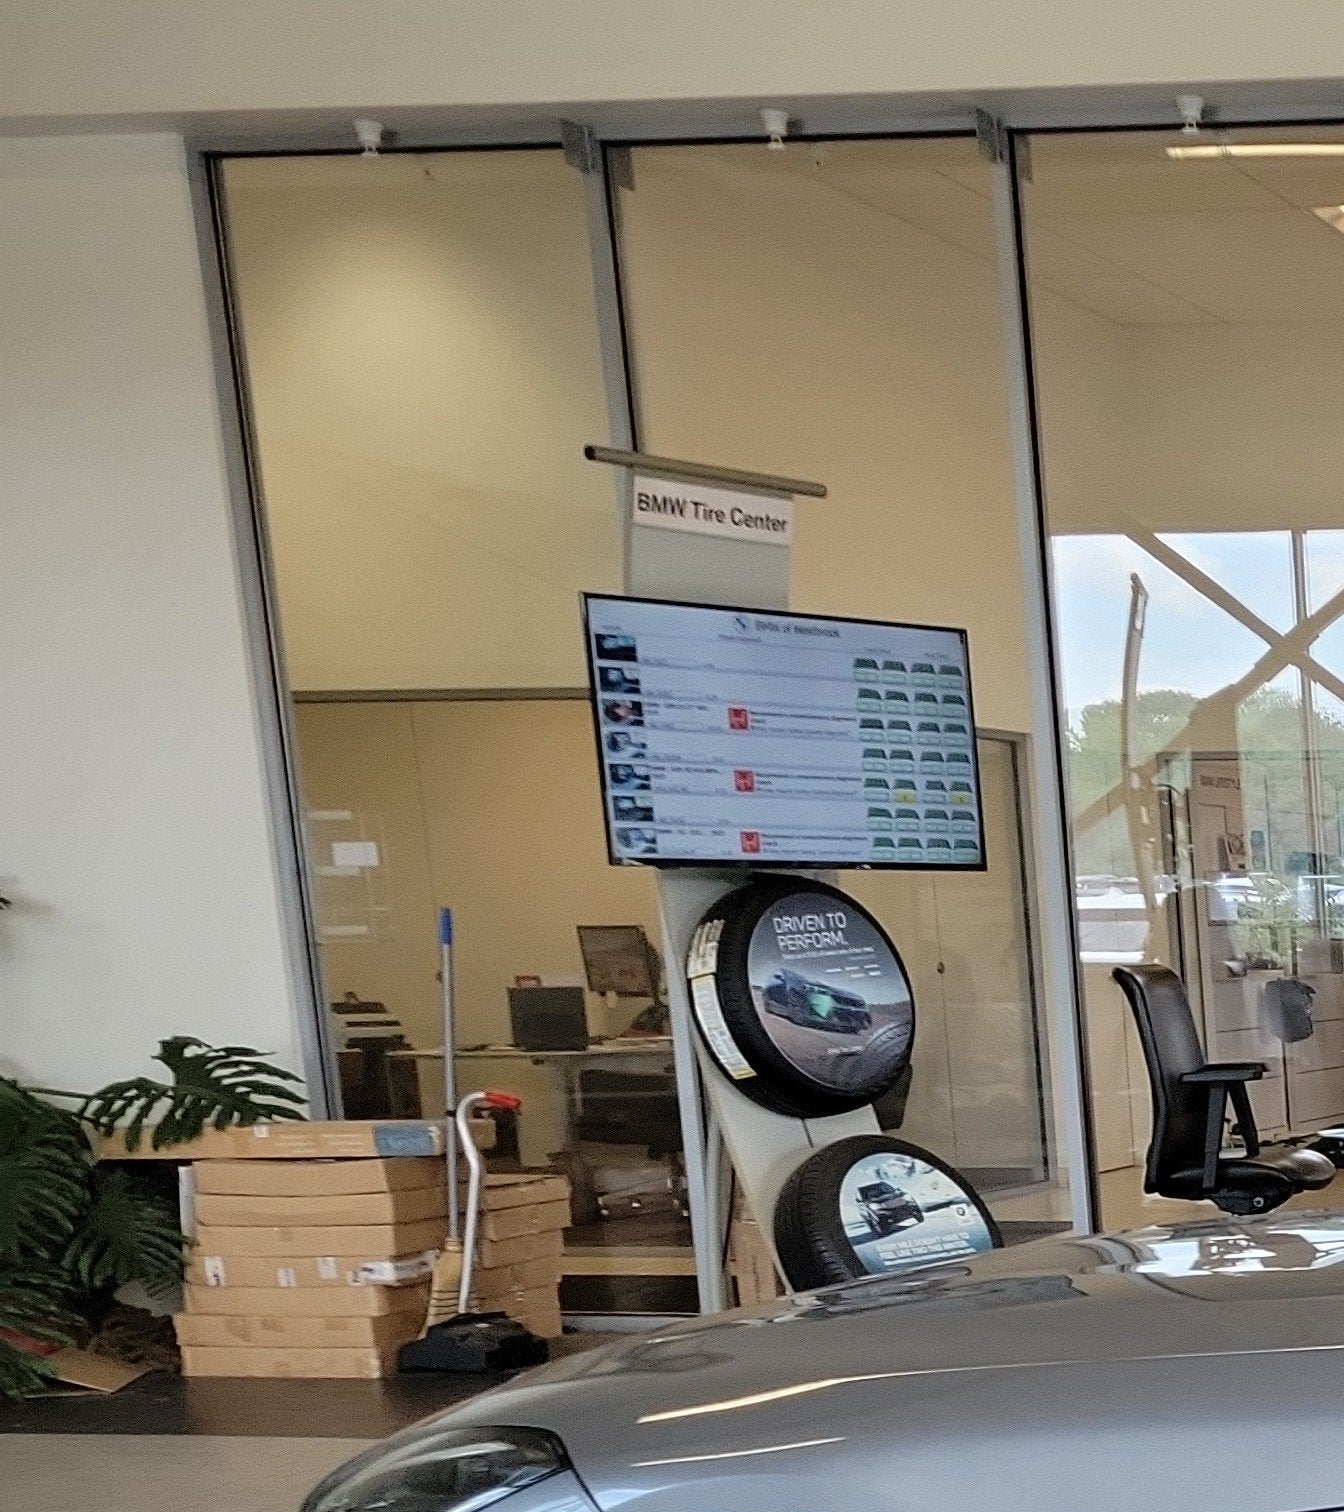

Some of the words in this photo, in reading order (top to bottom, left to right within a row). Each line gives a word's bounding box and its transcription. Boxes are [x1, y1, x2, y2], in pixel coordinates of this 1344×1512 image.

[637, 492, 688, 519] BMW
[691, 500, 726, 525] Tire
[729, 507, 789, 535] Center
[773, 913, 826, 934] DRIVEN
[826, 911, 847, 929] TO
